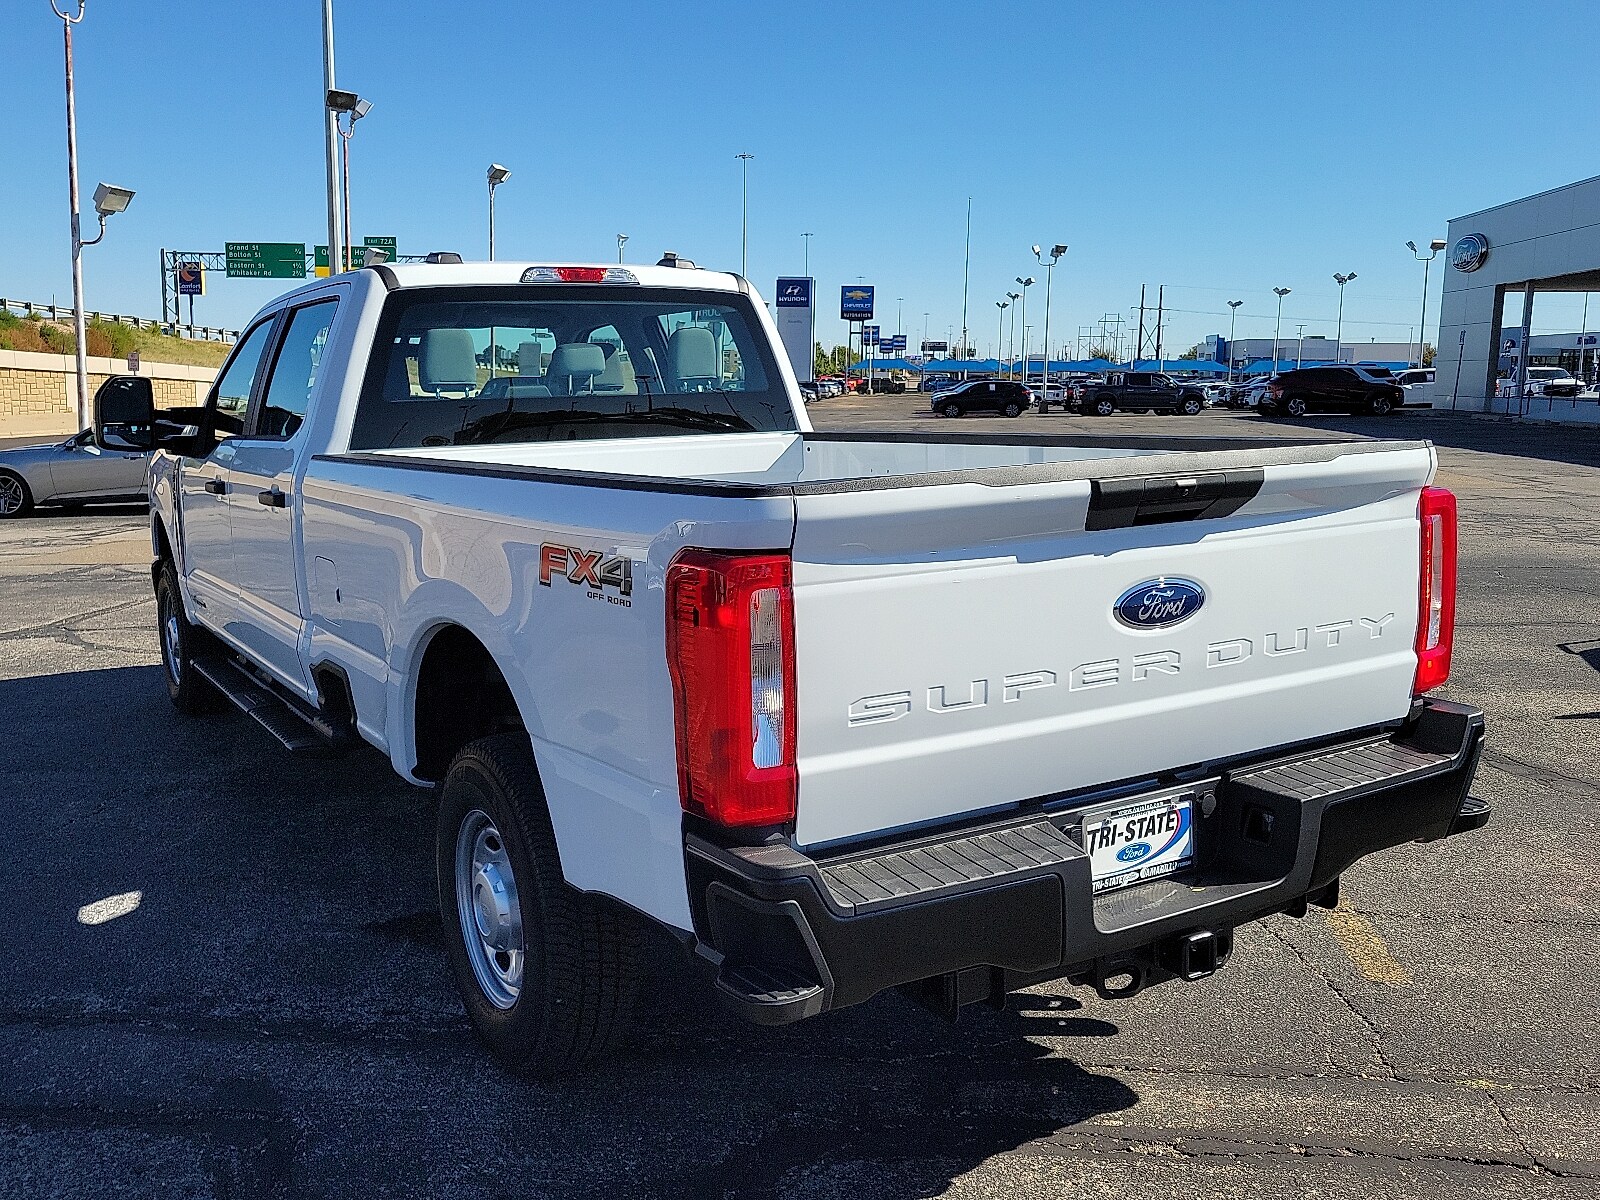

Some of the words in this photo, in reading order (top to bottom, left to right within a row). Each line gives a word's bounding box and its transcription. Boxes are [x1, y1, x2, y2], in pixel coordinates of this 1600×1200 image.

[539, 541, 632, 597] FX4
[586, 591, 605, 600] OFF
[607, 595, 632, 608] ROAD
[1137, 588, 1186, 622] Ford
[848, 650, 1182, 728] SUPER
[1206, 611, 1395, 669] DUTY
[1087, 810, 1177, 857] TRI-STATE
